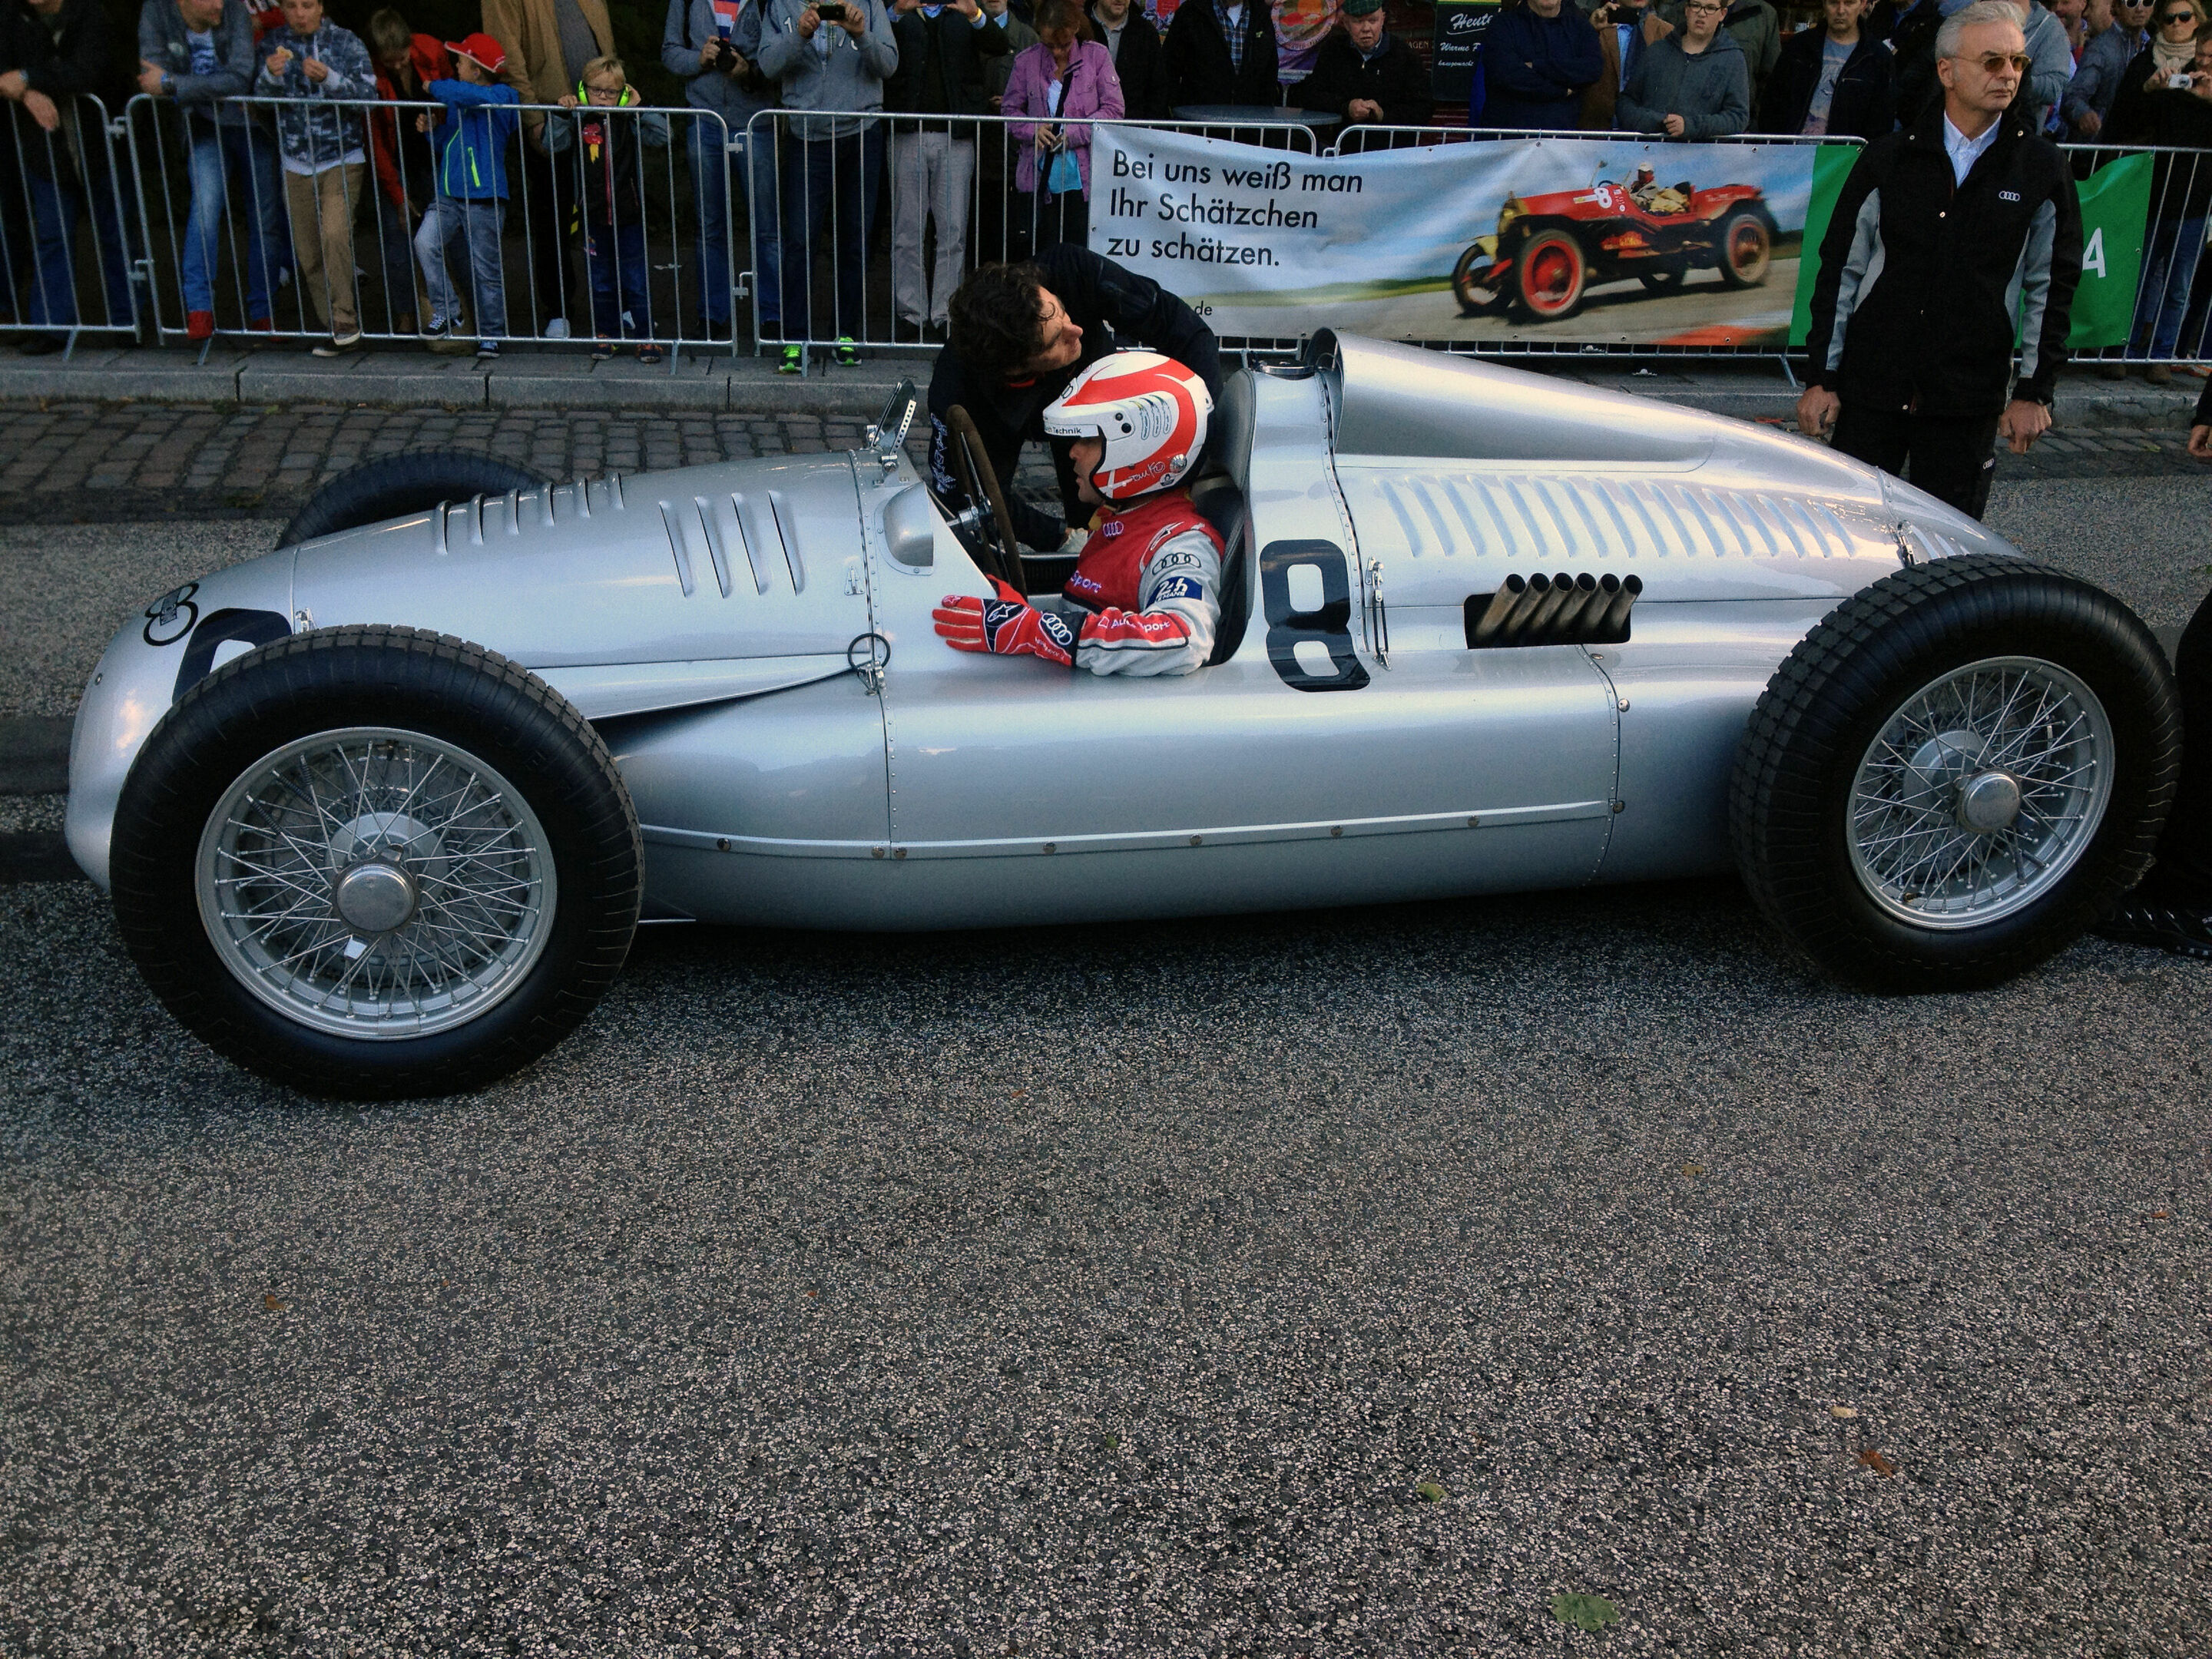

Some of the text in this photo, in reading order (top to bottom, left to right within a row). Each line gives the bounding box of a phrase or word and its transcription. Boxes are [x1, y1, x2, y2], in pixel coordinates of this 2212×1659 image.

[1440, 42, 1470, 51] Warme
[1113, 149, 1363, 193] Bei uns weiß man
[1110, 187, 1318, 228] Ihr Schätzchen
[1106, 231, 1280, 267] zu schätzen.
[1052, 426, 1082, 435] Technik
[143, 582, 200, 647] 8
[1259, 539, 1371, 693] 8
